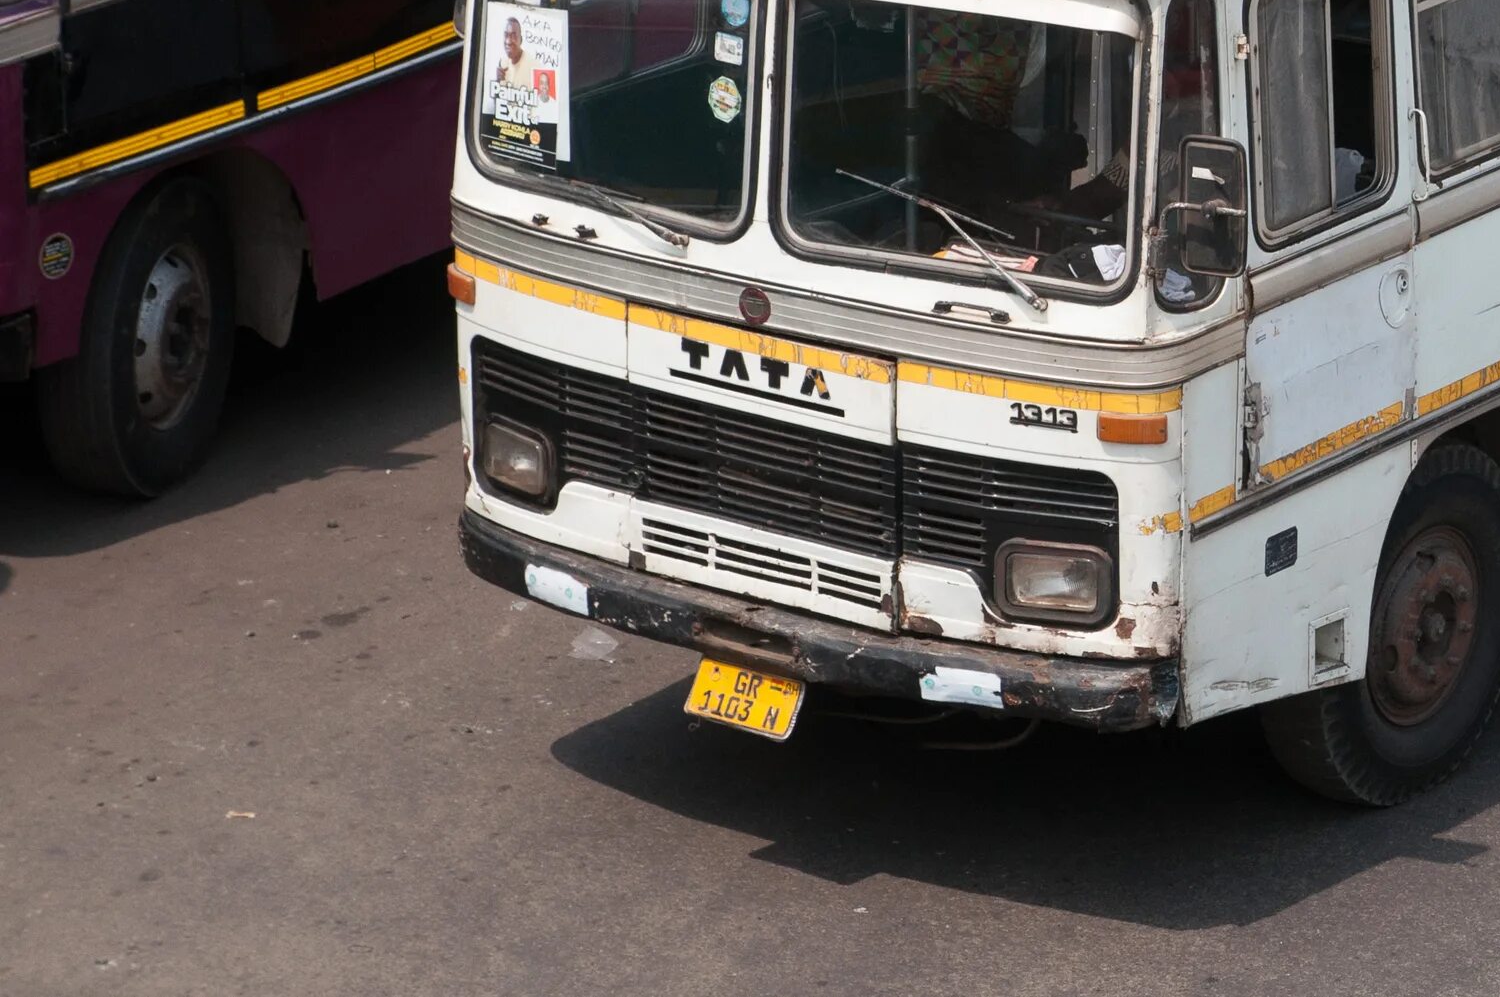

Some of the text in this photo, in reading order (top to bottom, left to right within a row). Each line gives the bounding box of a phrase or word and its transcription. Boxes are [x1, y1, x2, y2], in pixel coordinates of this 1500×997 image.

[522, 15, 552, 32] AKA
[525, 30, 563, 53] BONGO
[490, 80, 539, 107] Painful
[681, 336, 831, 401] TATA
[1009, 402, 1079, 431] 1313
[734, 671, 763, 699] GR
[698, 690, 754, 722] 1103
